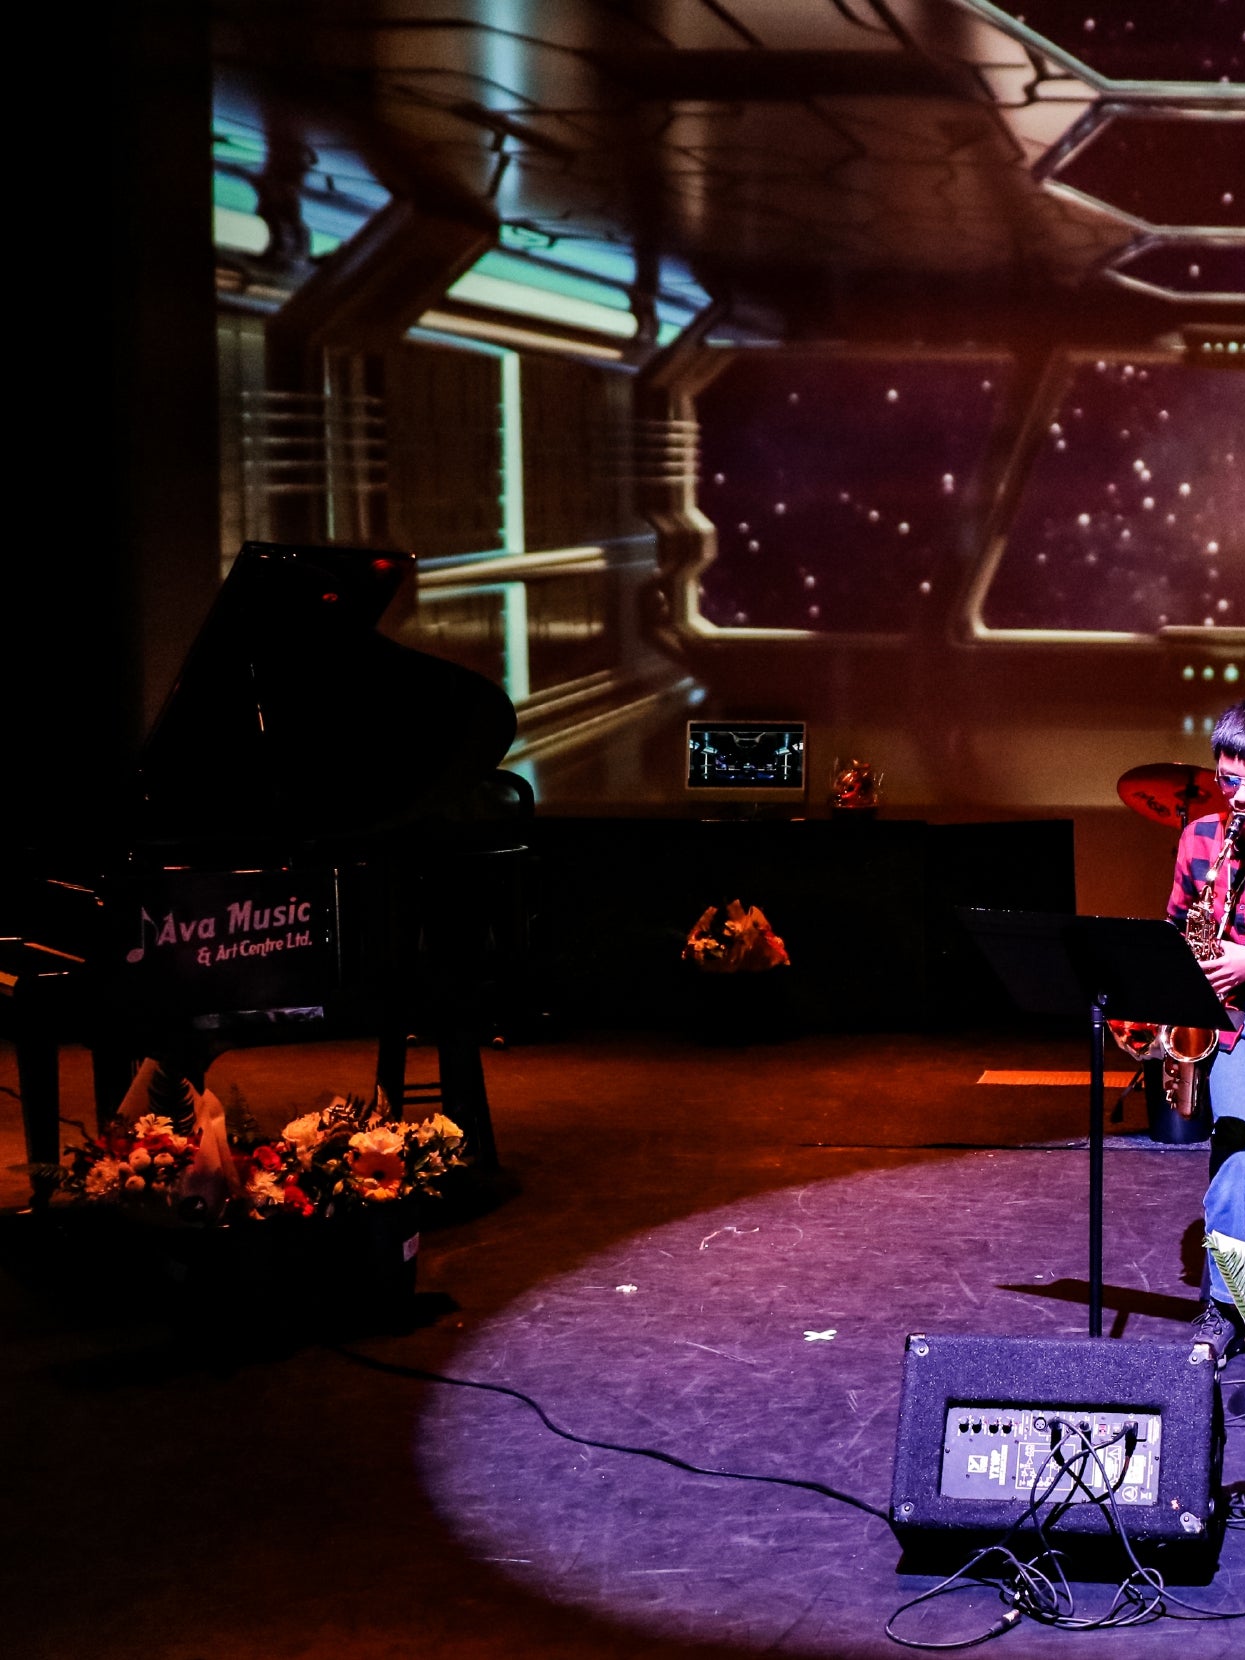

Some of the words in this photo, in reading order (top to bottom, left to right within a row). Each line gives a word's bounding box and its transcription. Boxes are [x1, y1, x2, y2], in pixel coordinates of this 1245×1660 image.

[157, 912, 216, 946] Ava
[227, 896, 311, 934] Music
[197, 946, 212, 967] &
[215, 942, 239, 962] Art
[239, 937, 284, 957] Centre
[285, 930, 313, 949] Ltd.
